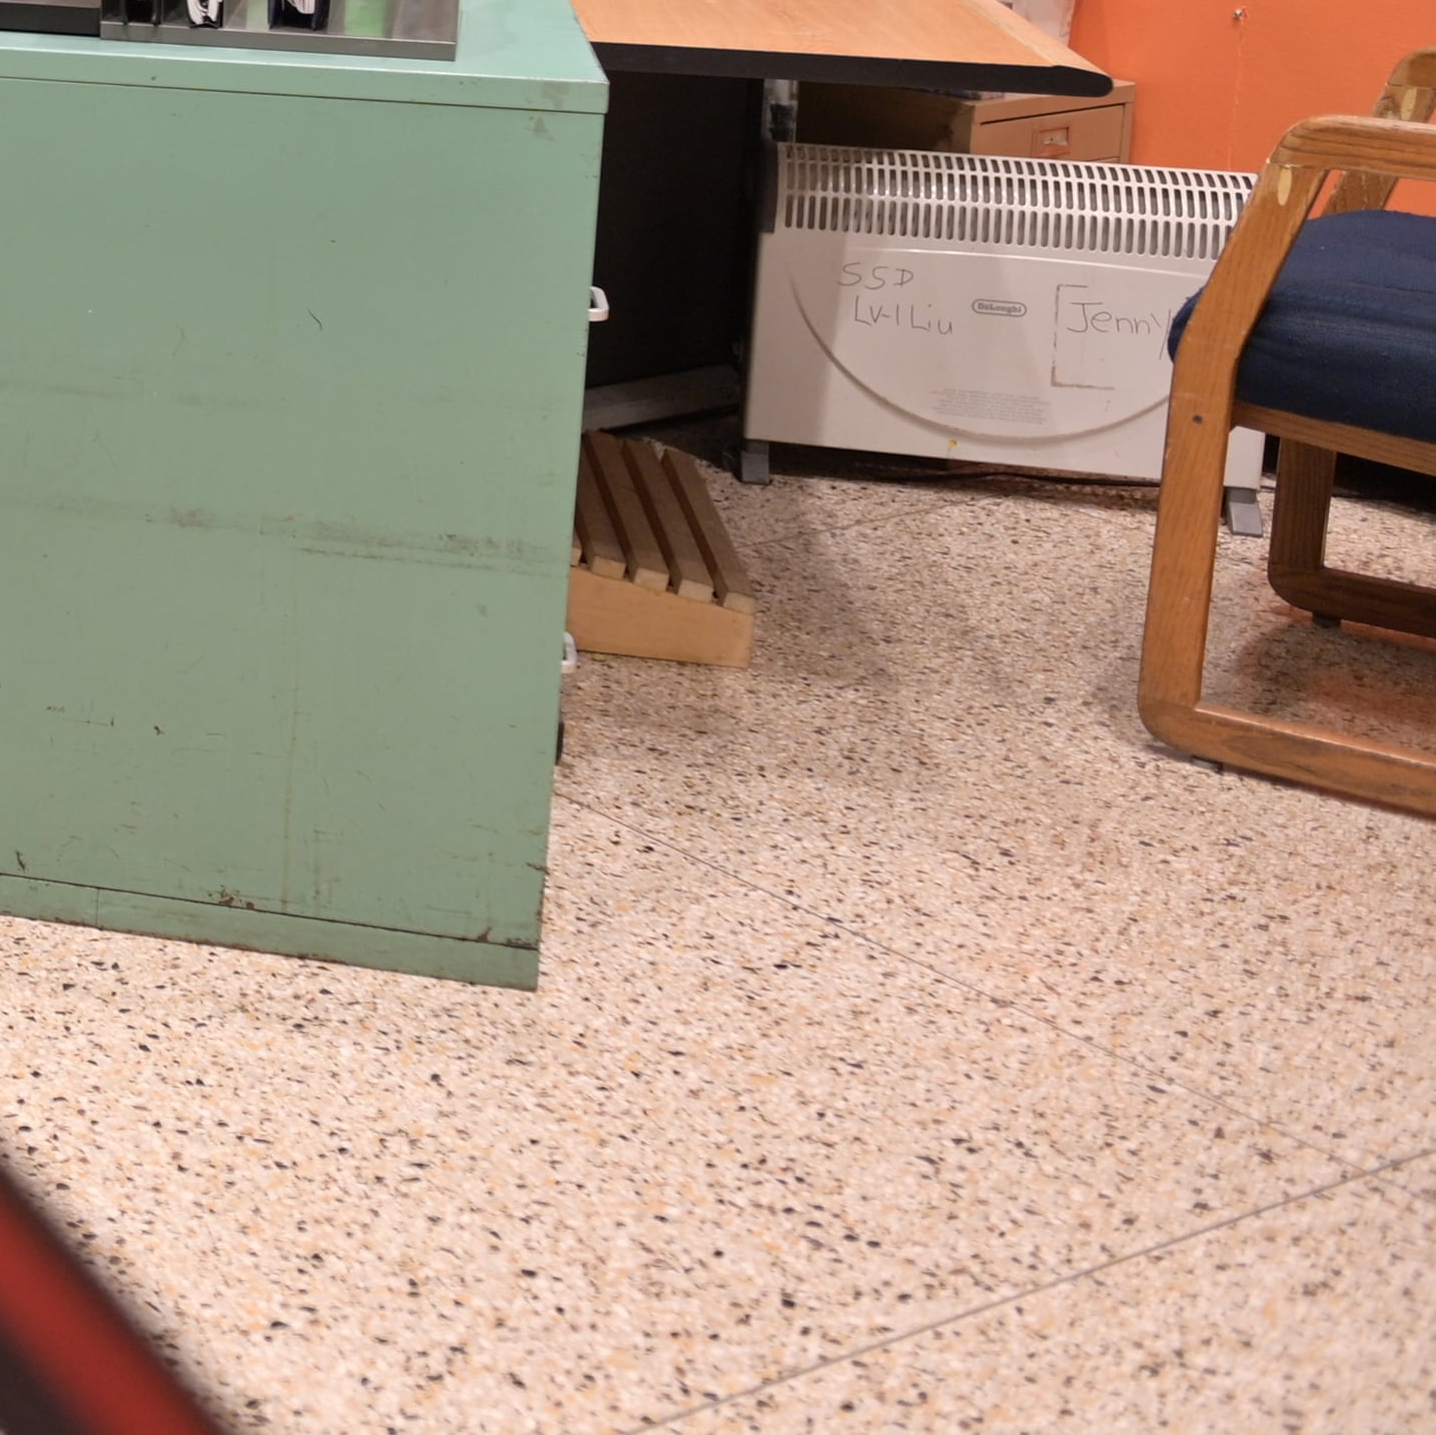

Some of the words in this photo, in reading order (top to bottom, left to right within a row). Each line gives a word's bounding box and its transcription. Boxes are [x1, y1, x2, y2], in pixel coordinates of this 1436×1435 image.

[837, 262, 914, 290] SSD
[910, 303, 953, 335] Liu
[1066, 301, 1173, 361] Jenny
